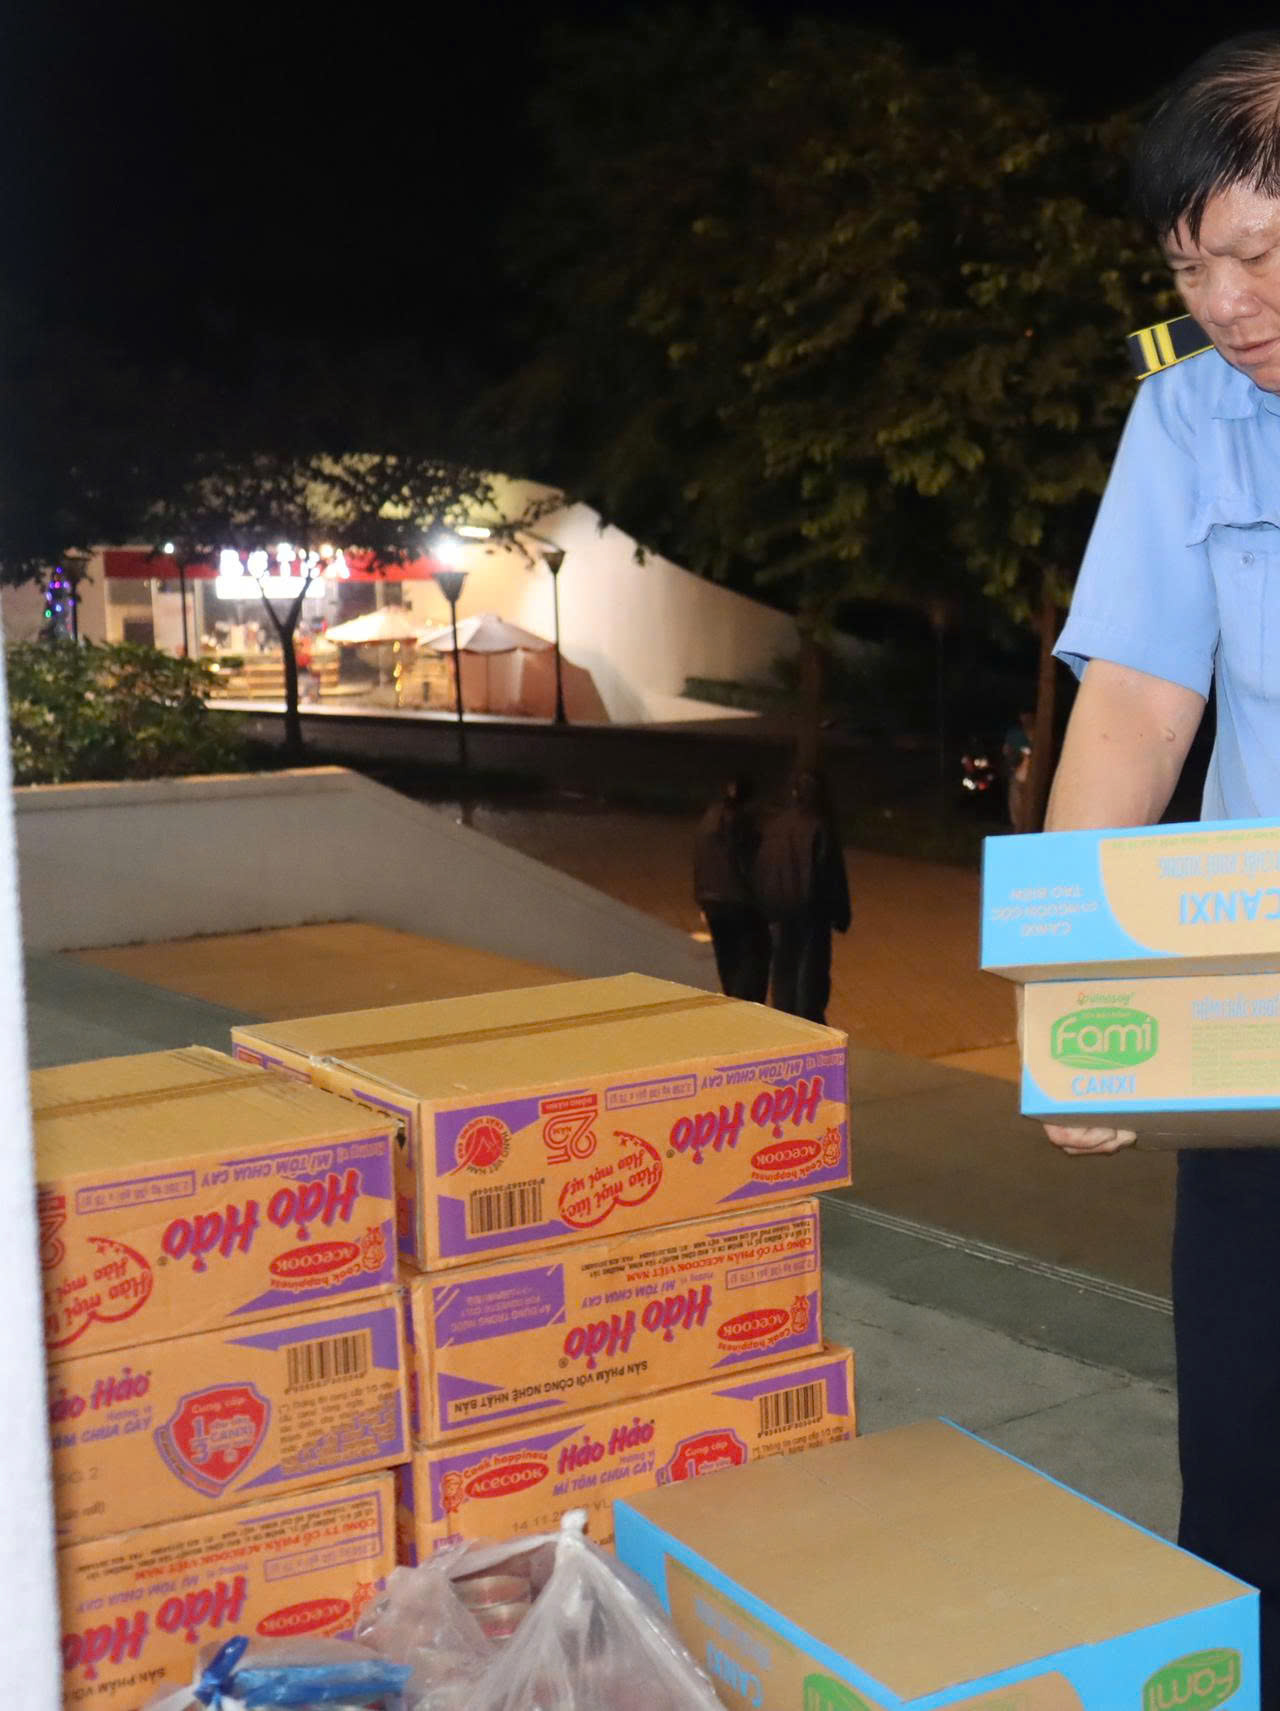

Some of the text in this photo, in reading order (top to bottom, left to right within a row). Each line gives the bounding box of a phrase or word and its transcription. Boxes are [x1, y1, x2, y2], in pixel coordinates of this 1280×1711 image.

[1072, 1074, 1137, 1097] CANXI
[541, 1108, 599, 1167] 25
[669, 1075, 824, 1165] Hảo Hảo
[159, 1169, 361, 1273] Hảo Hảo
[562, 1284, 713, 1369] Hảo Hảo
[91, 1366, 150, 1411] Hảo
[543, 1377, 575, 1393] CÔNG
[557, 1416, 655, 1475] Hảo Hảo
[155, 1575, 248, 1645] Hảo
